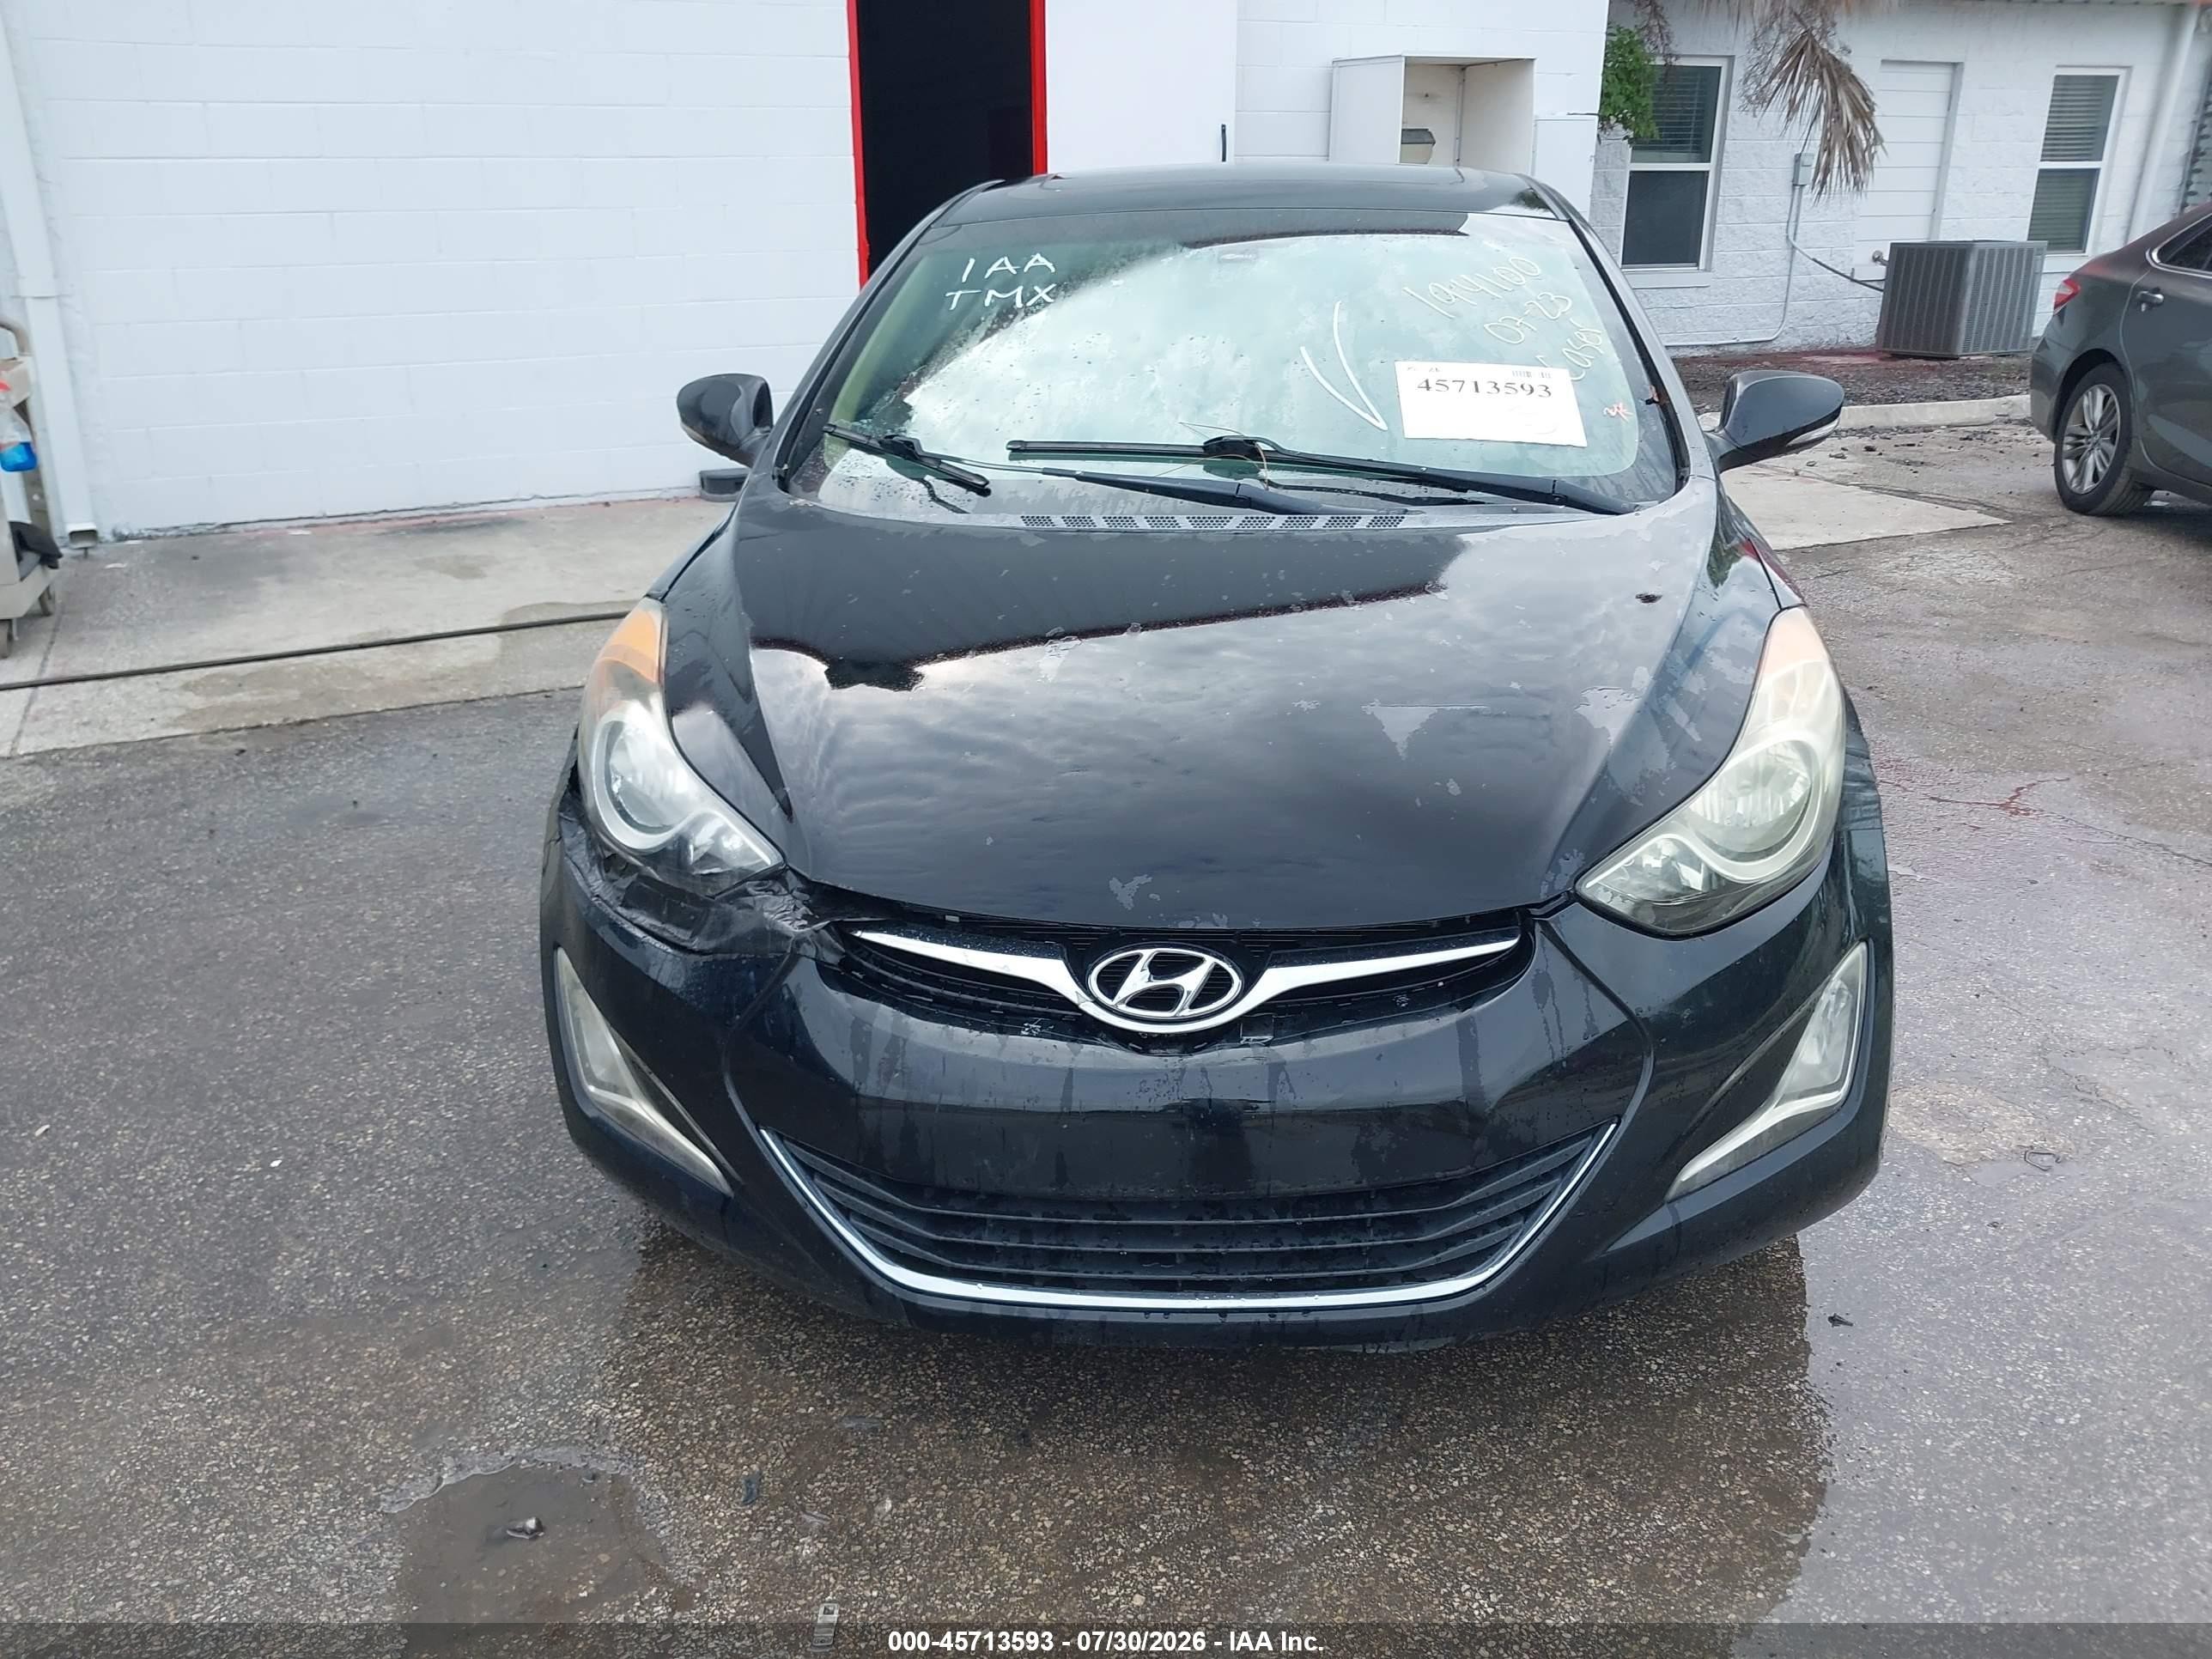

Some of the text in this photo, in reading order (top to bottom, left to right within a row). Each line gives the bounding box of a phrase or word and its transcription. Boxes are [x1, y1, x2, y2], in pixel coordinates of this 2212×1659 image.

[961, 252, 1056, 283] IAA
[945, 283, 1058, 311] TMX
[1417, 378, 1552, 398] 45713593
